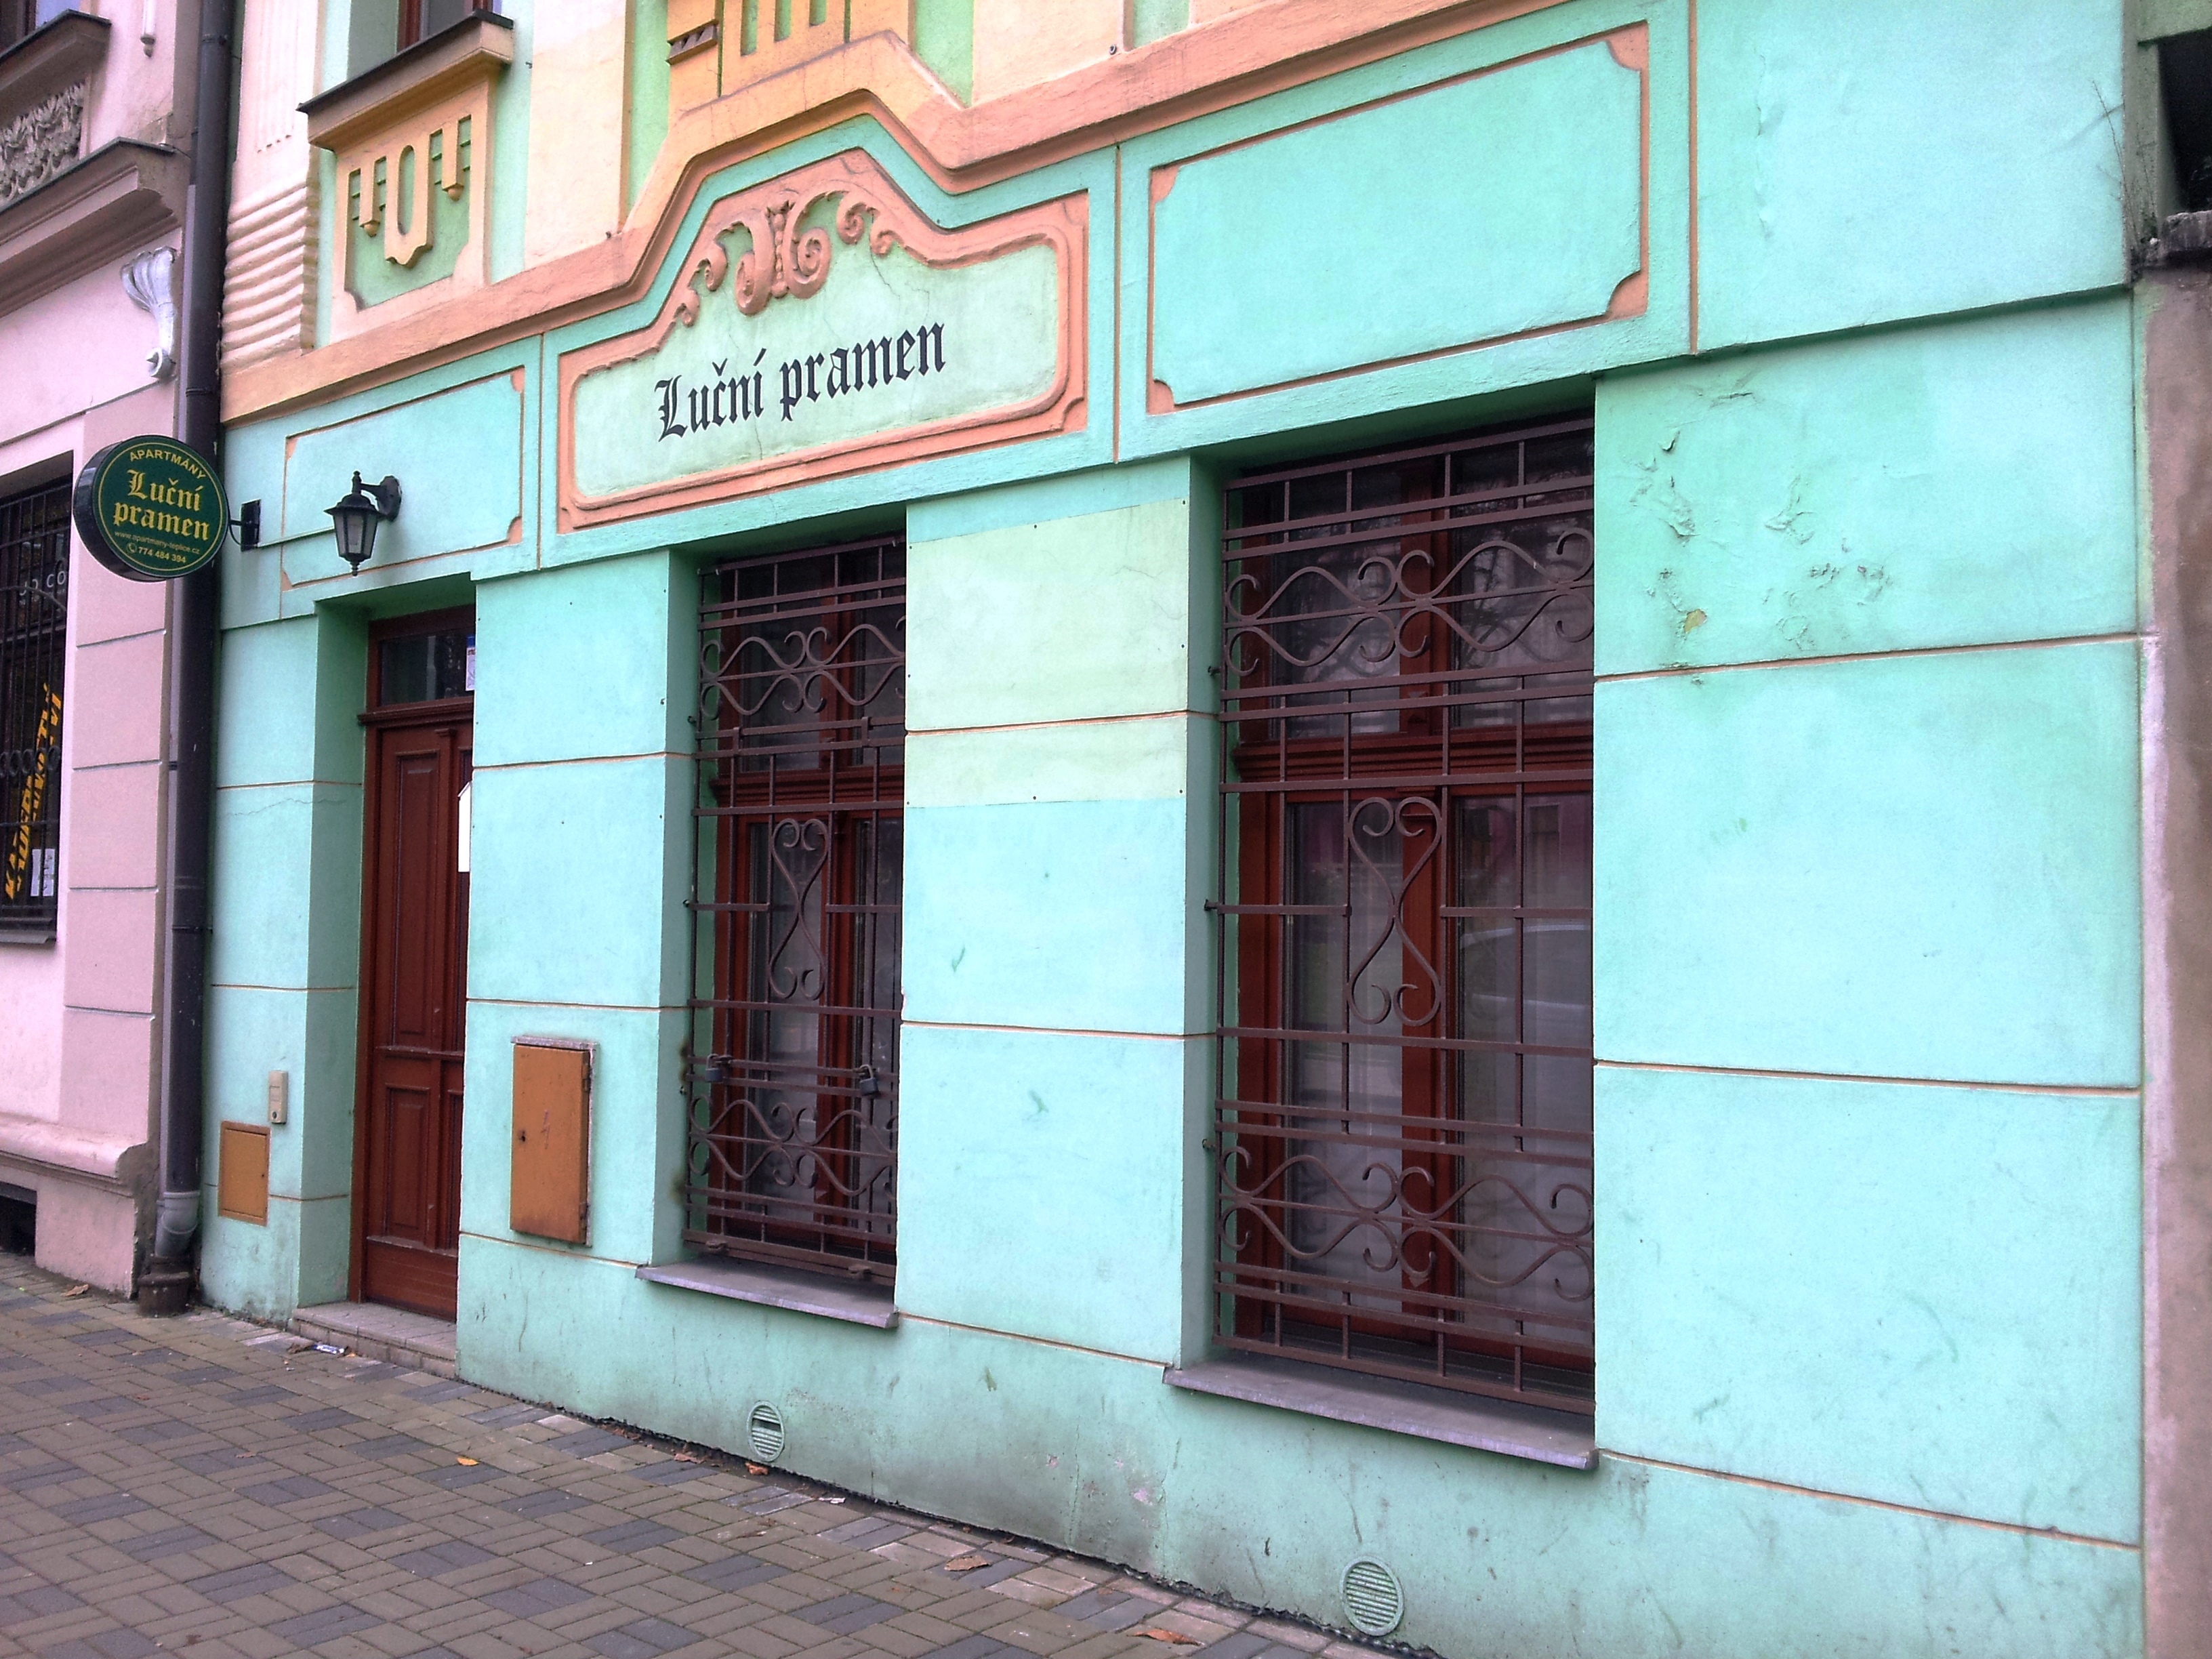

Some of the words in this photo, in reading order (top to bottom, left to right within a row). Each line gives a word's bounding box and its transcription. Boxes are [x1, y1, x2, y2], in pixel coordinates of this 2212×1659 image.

[654, 348, 767, 443] Luční
[779, 322, 946, 422] pramen
[130, 449, 206, 478] APARTMÁNY
[127, 469, 203, 512] Luční
[113, 502, 209, 541] pramen
[138, 546, 153, 556] 774
[155, 550, 170, 560] 484
[171, 554, 186, 563] 394
